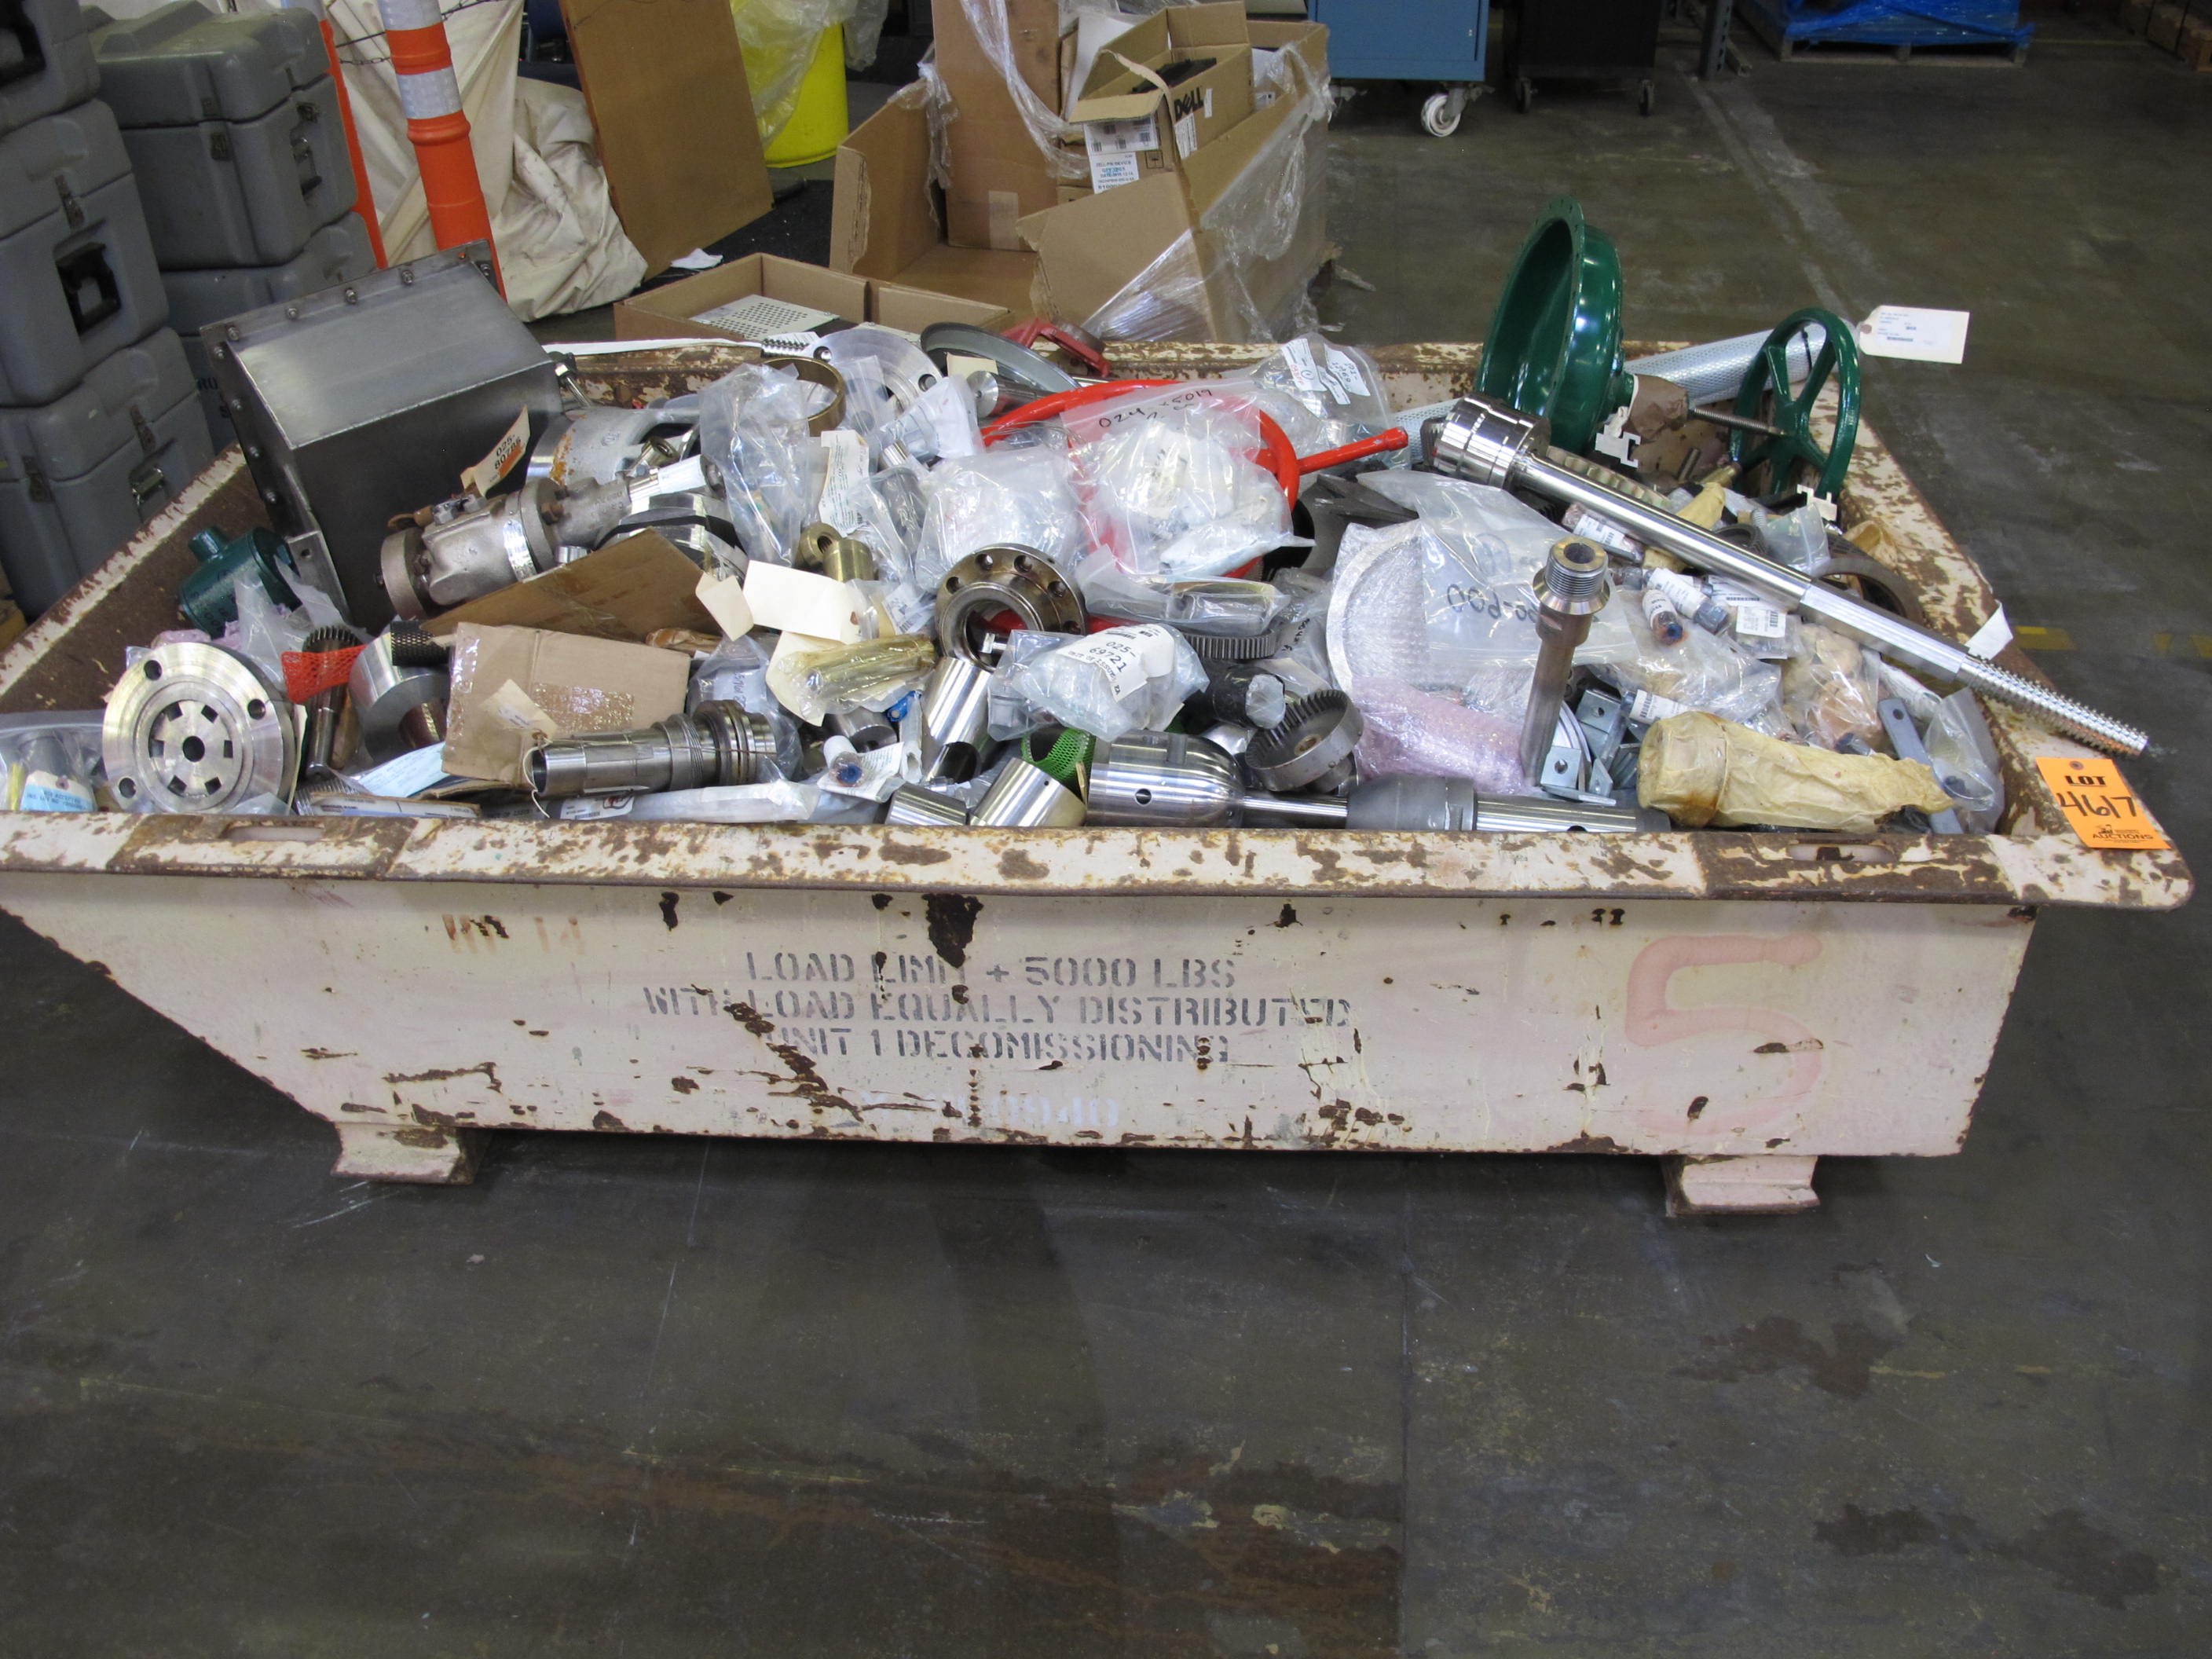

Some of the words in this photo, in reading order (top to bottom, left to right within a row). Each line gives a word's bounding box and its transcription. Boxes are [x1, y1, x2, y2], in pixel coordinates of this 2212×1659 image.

[1174, 87, 1204, 123] DELL
[1090, 646, 1127, 673] 69721
[1106, 641, 1137, 657] 025-
[2064, 775, 2107, 786] LOT
[2056, 790, 2137, 819] 4617
[747, 951, 855, 982] LOAD
[1025, 957, 1137, 987] 5000
[1154, 958, 1236, 988] LBS
[749, 989, 854, 1019] LOAD
[870, 992, 1060, 1024] EQUALLY
